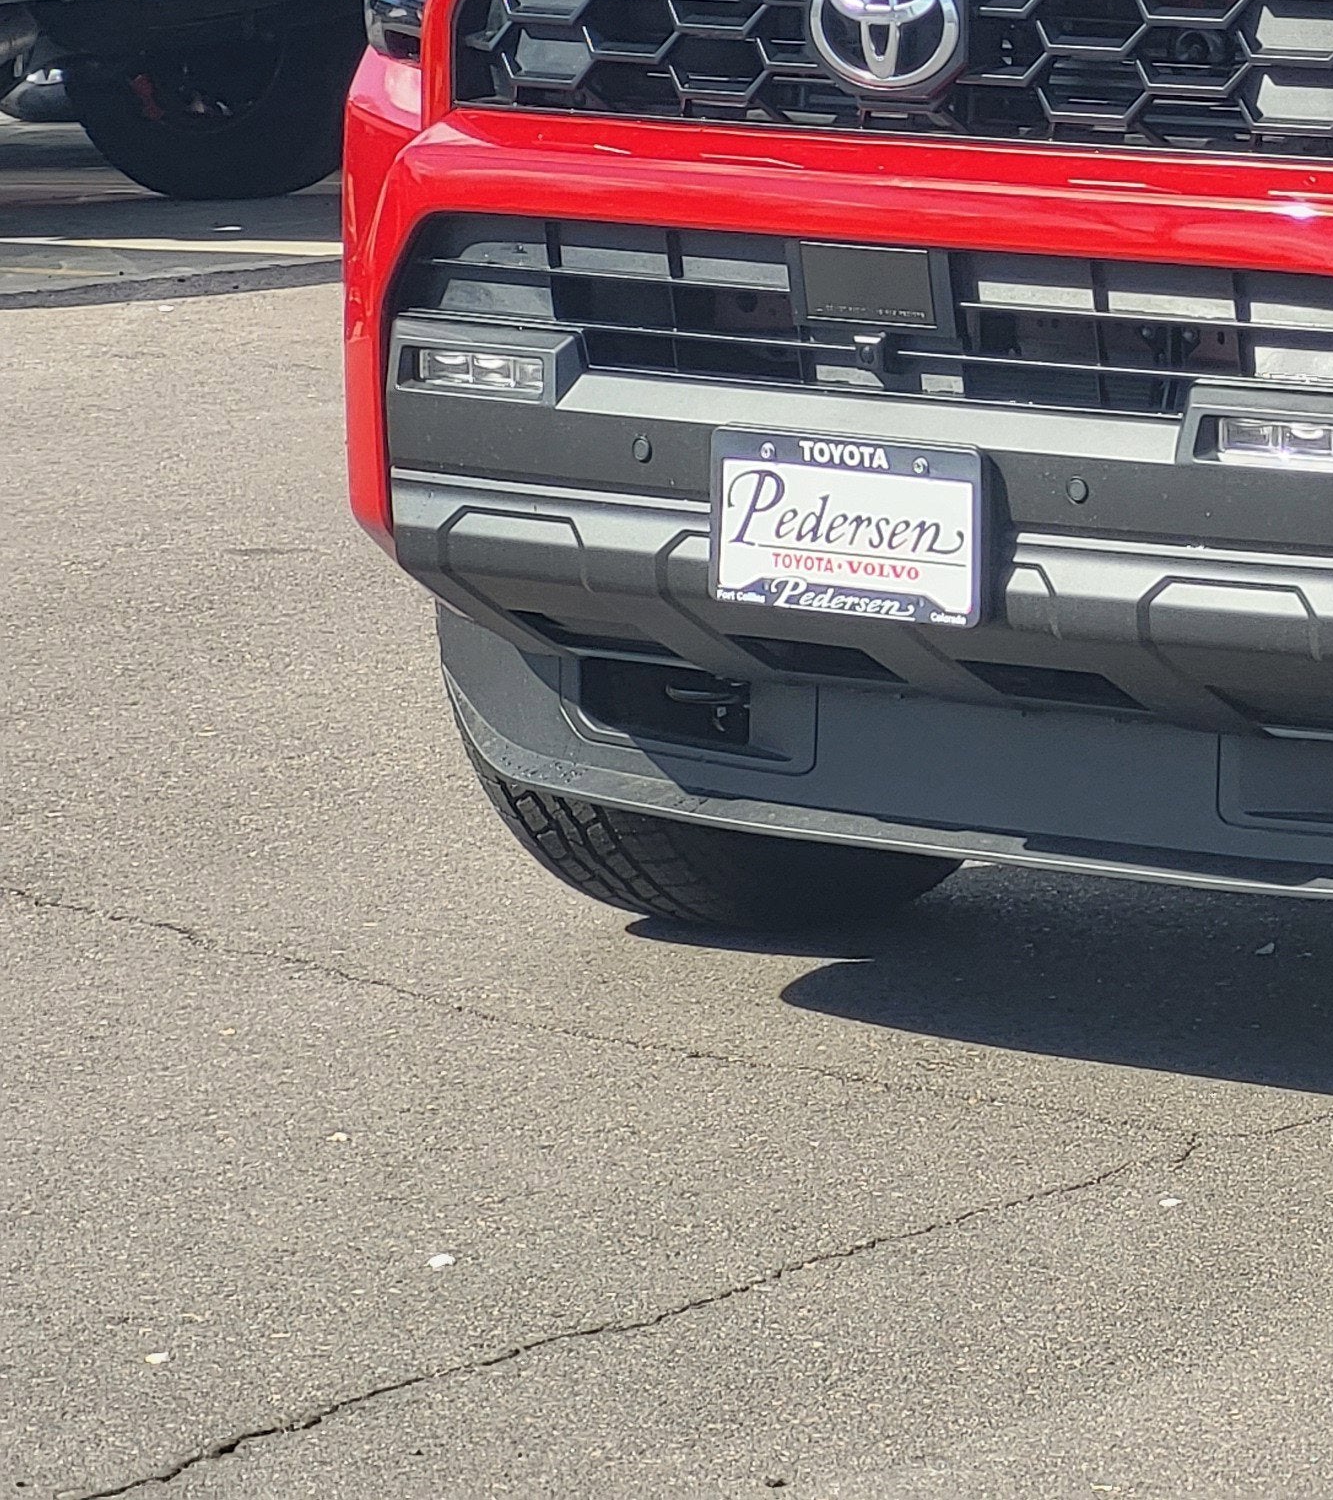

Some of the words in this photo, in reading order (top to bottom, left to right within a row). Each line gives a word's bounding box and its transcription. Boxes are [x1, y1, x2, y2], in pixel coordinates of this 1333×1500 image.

[798, 440, 889, 470] TOYOTA
[728, 469, 965, 556] Pedersen
[771, 552, 835, 574] TOYOTA
[845, 560, 921, 581] VOLVO
[770, 576, 916, 617] Pedersen
